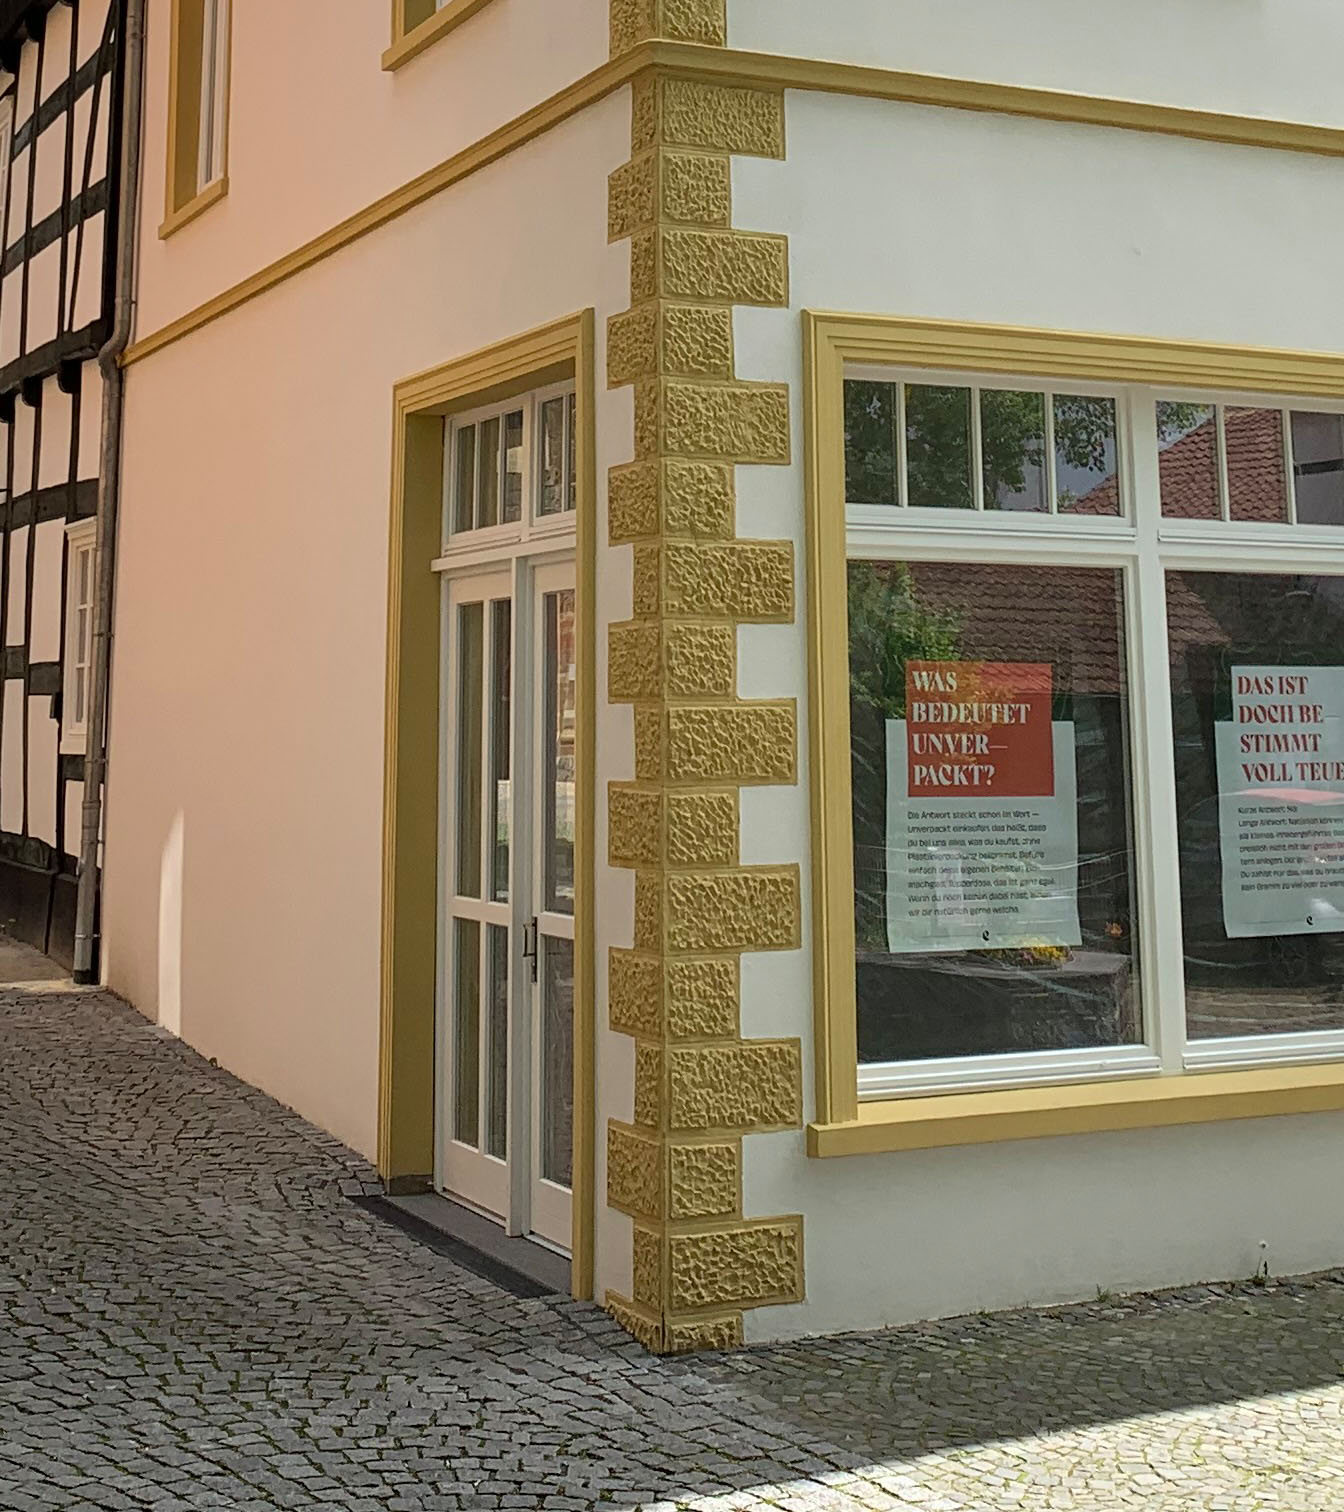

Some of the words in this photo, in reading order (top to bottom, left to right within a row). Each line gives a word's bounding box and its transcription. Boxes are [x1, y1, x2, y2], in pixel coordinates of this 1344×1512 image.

[912, 670, 958, 692] WAS
[1237, 676, 1274, 696] DAS
[1278, 676, 1309, 695] IST
[912, 702, 1031, 724] BEDEUTET
[1238, 704, 1295, 724] DOCH
[1240, 733, 1322, 754] STIMMT
[913, 764, 996, 786] PACKT?
[1241, 763, 1293, 783] VOLL
[921, 811, 951, 819] Antwort
